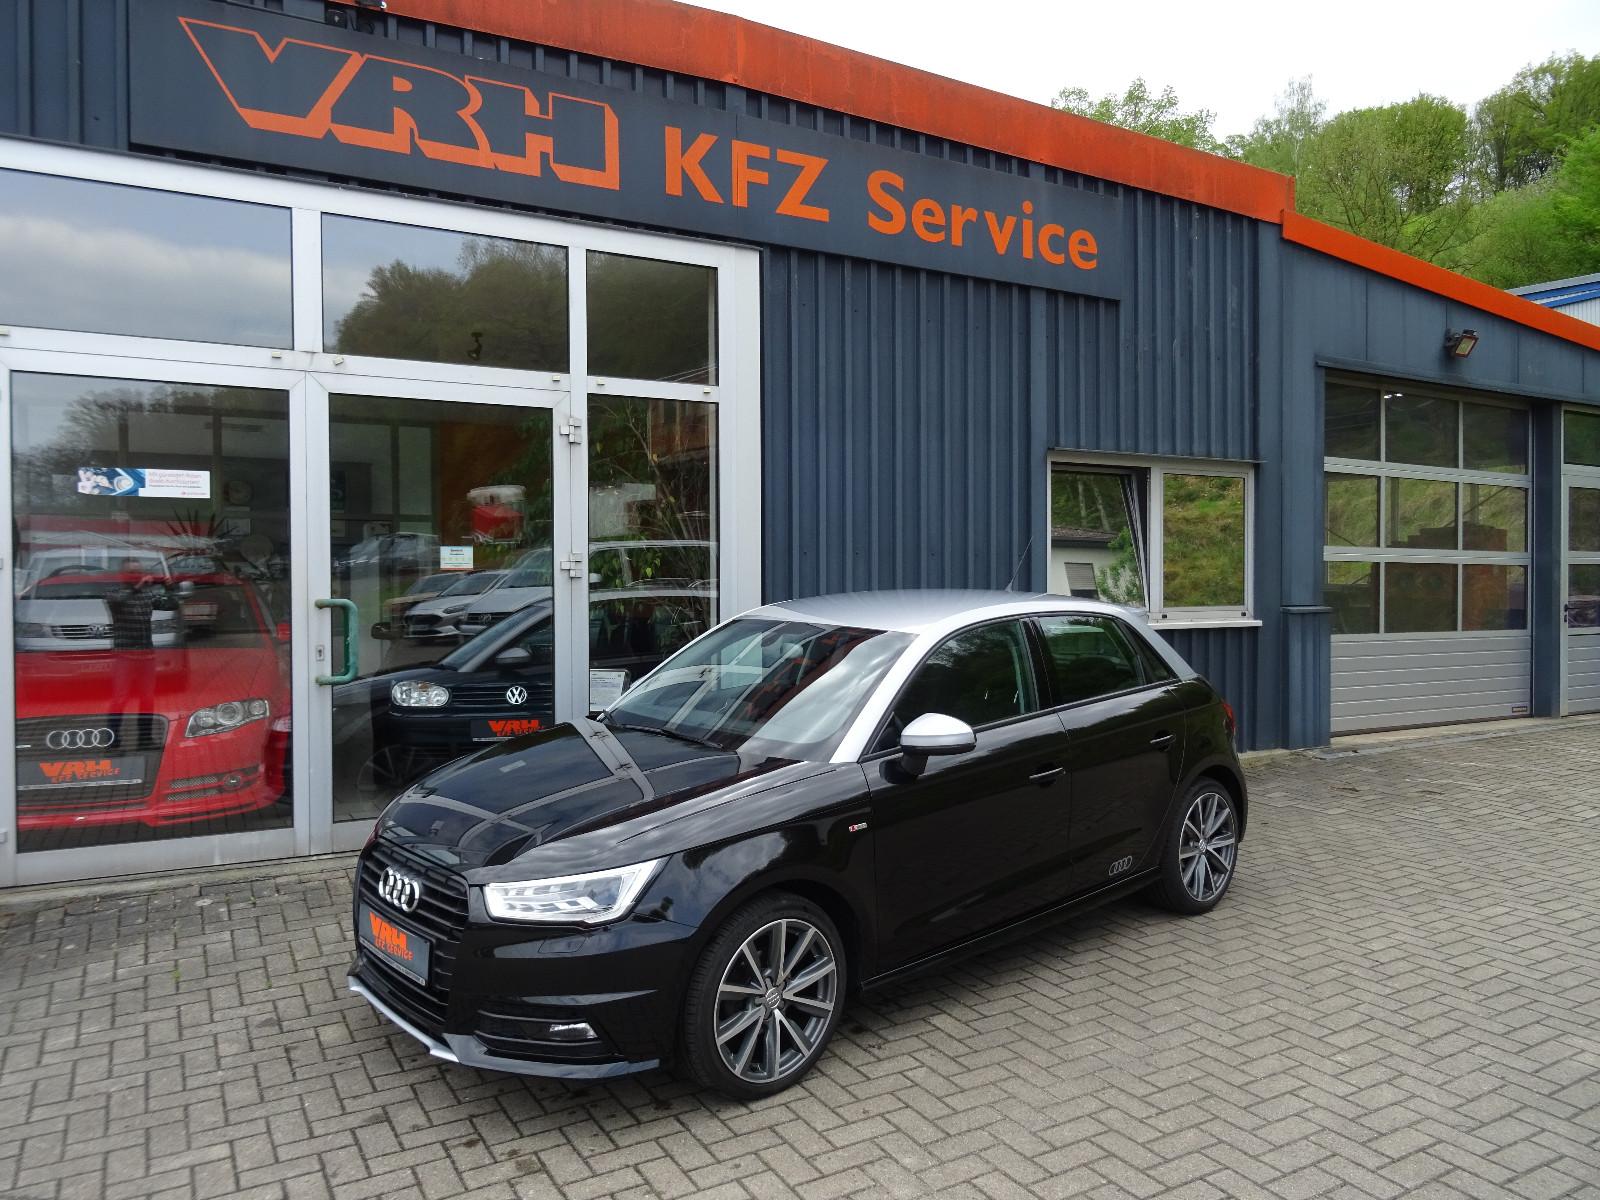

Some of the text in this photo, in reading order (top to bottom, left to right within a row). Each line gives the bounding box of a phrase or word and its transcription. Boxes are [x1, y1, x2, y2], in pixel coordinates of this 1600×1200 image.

[178, 16, 1098, 270] VRH KFZ Service
